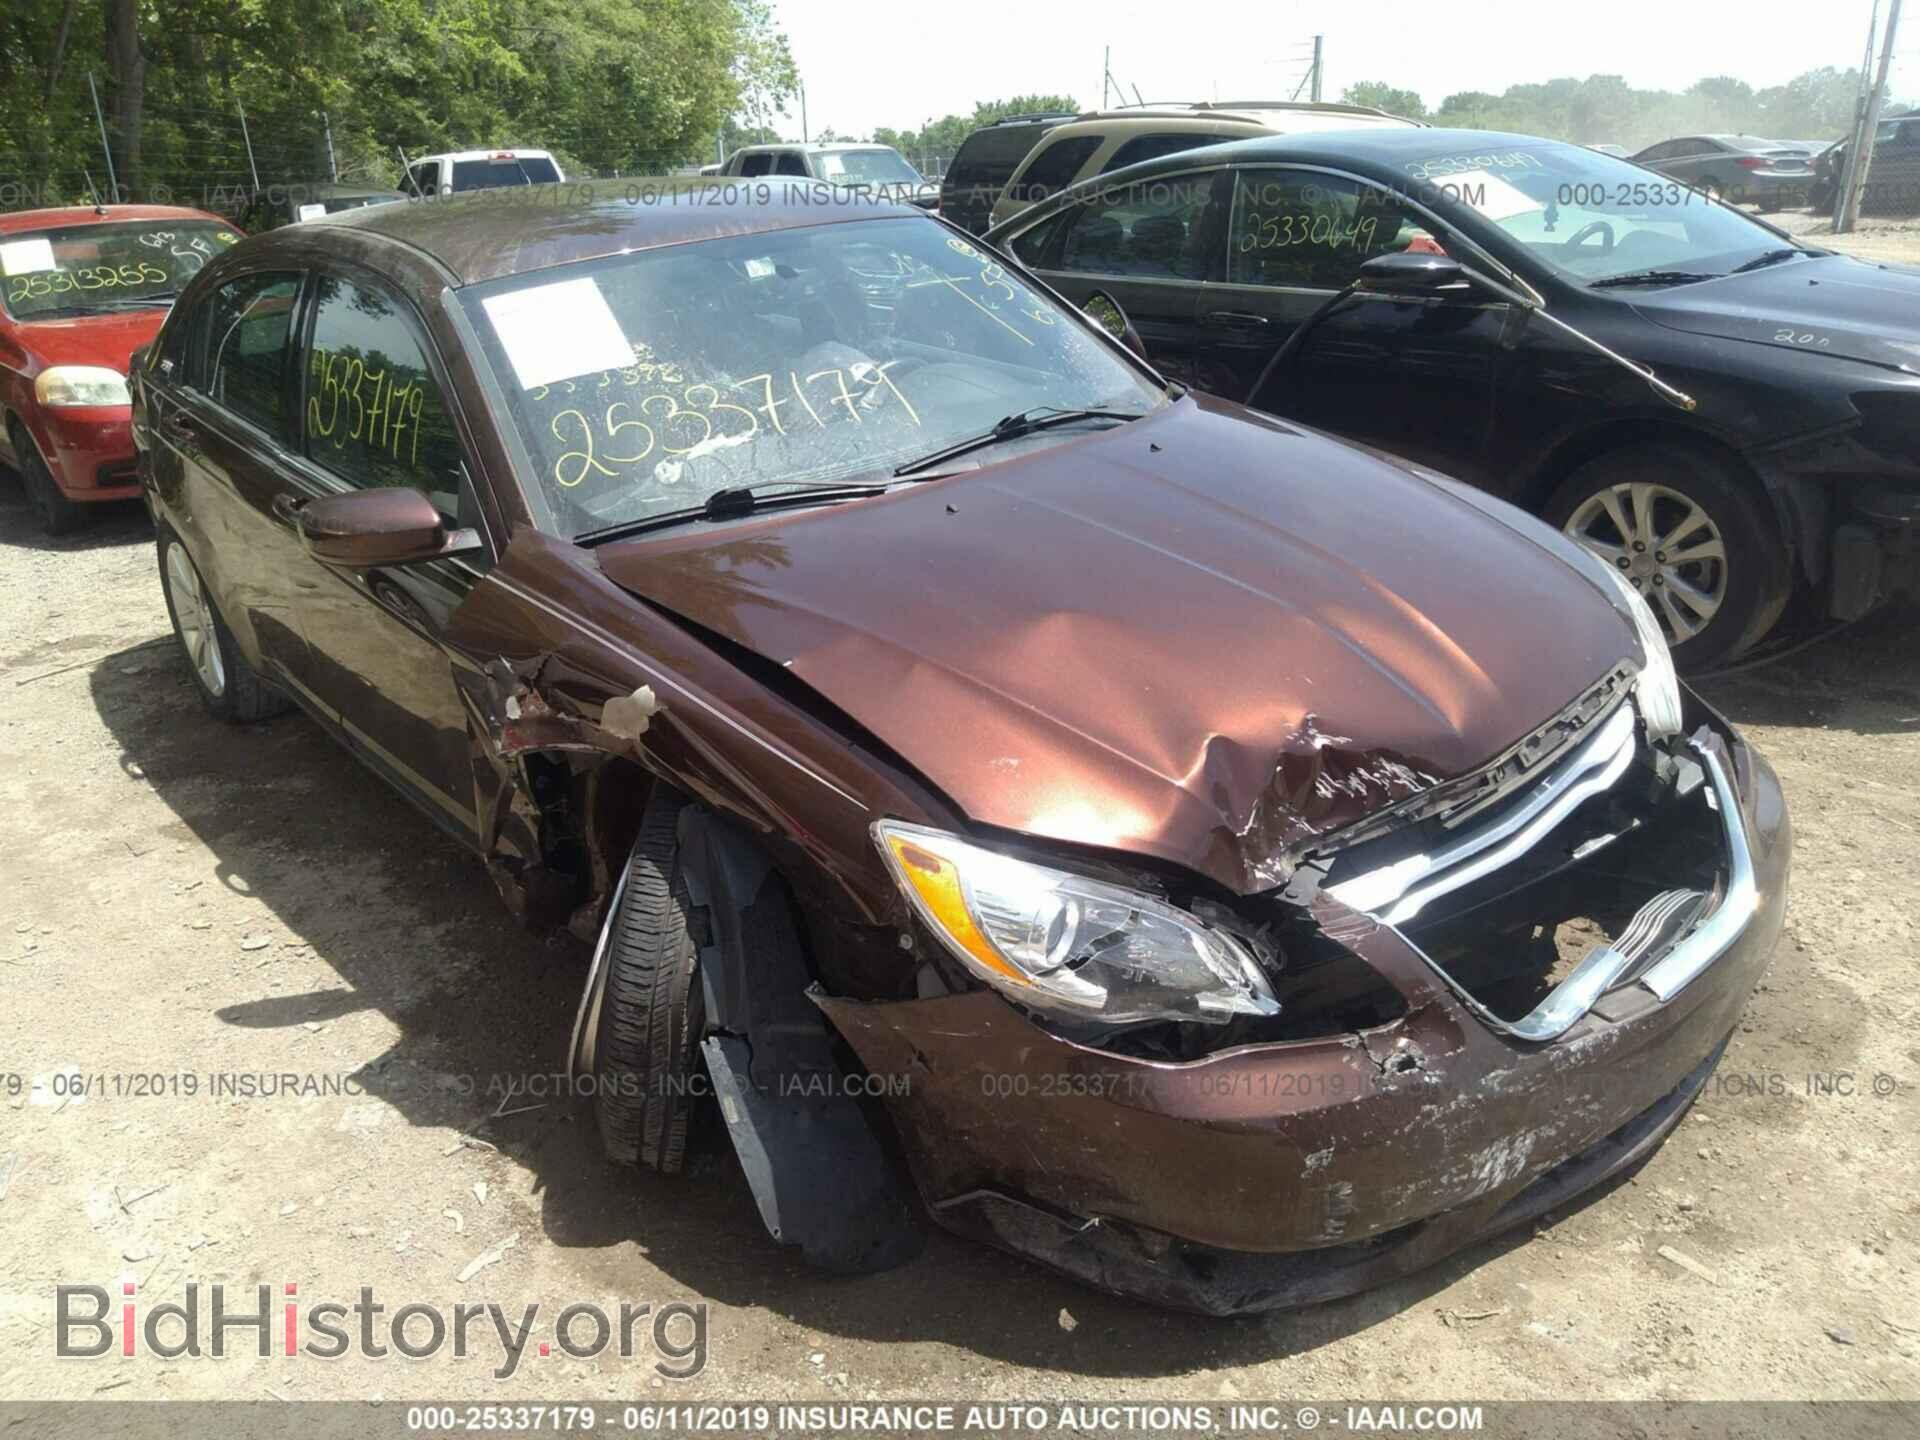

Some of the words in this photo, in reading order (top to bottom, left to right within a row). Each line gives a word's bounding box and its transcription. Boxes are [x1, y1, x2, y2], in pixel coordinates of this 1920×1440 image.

[1240, 213, 1379, 255] 25330649
[8, 262, 168, 302] 25313255
[308, 348, 424, 466] 25337179
[552, 358, 921, 487] 25337179
